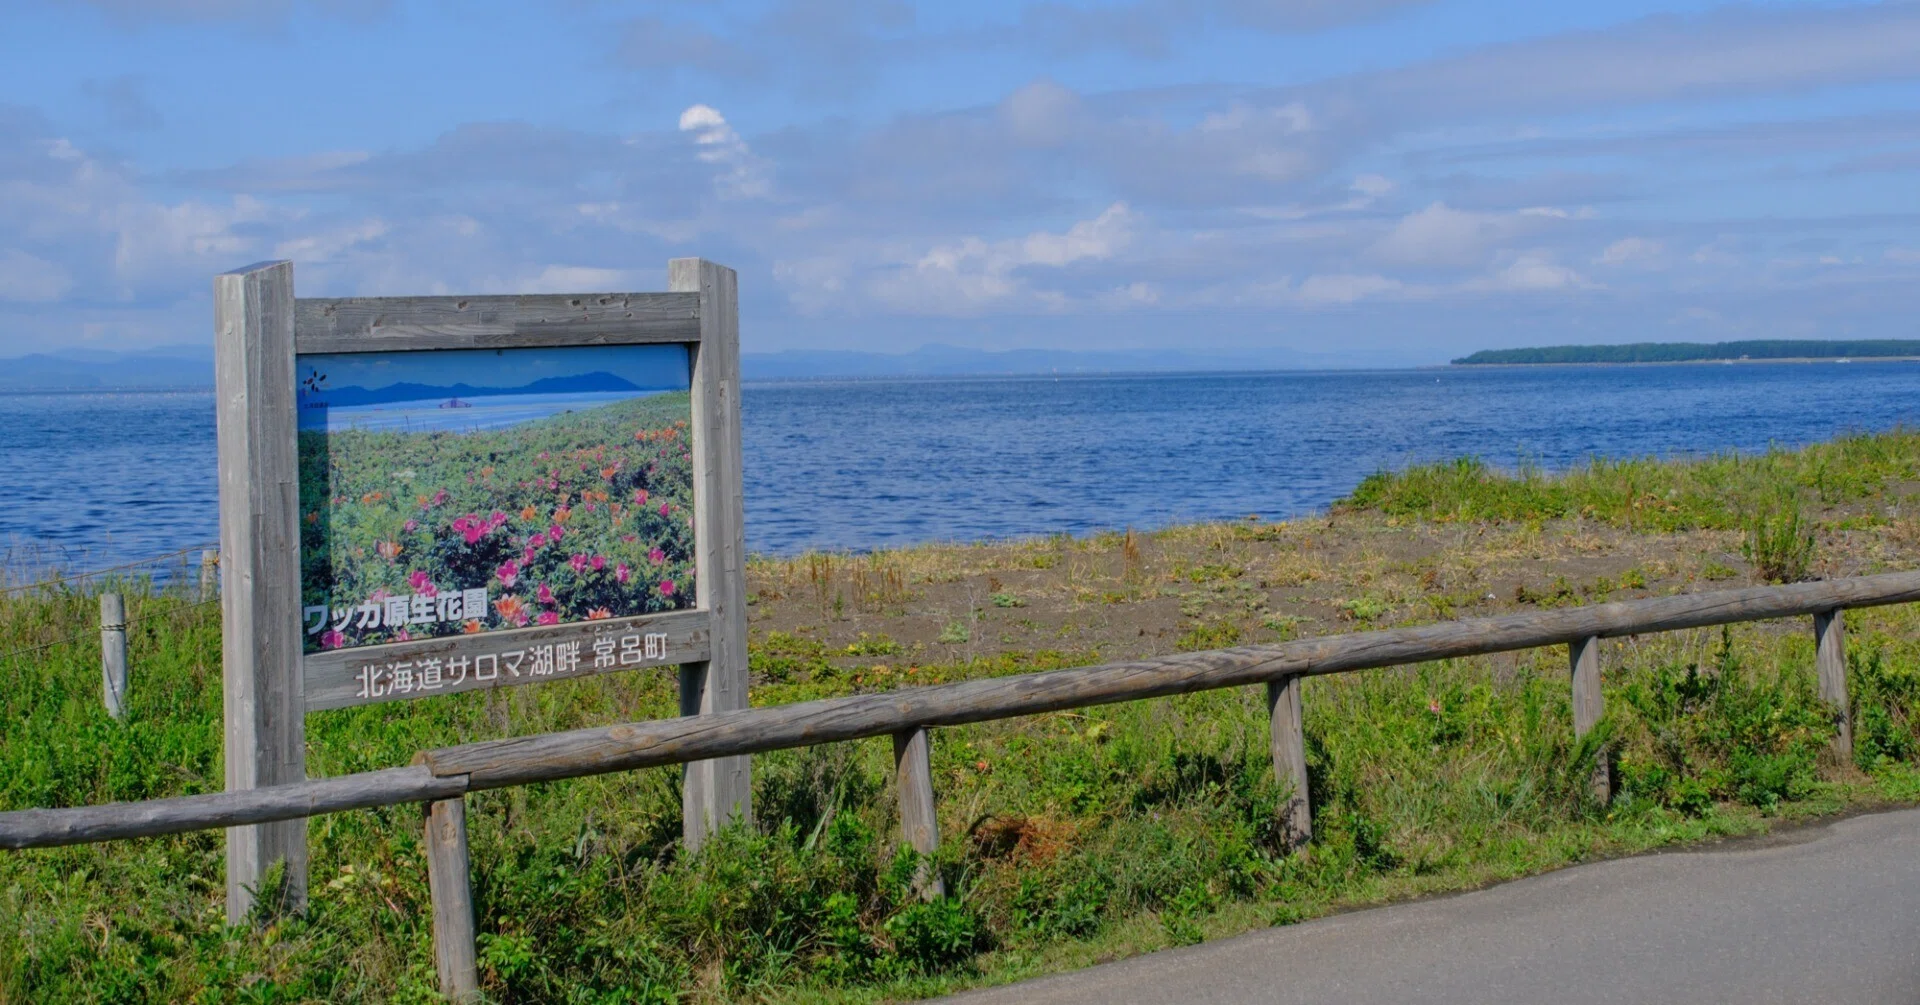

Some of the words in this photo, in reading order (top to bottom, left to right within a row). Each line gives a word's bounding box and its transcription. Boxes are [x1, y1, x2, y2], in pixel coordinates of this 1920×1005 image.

[304, 587, 488, 635] ワッカ原生花園
[355, 640, 581, 699] 北海道サロマ湖畔
[592, 633, 668, 668] 常呂町
